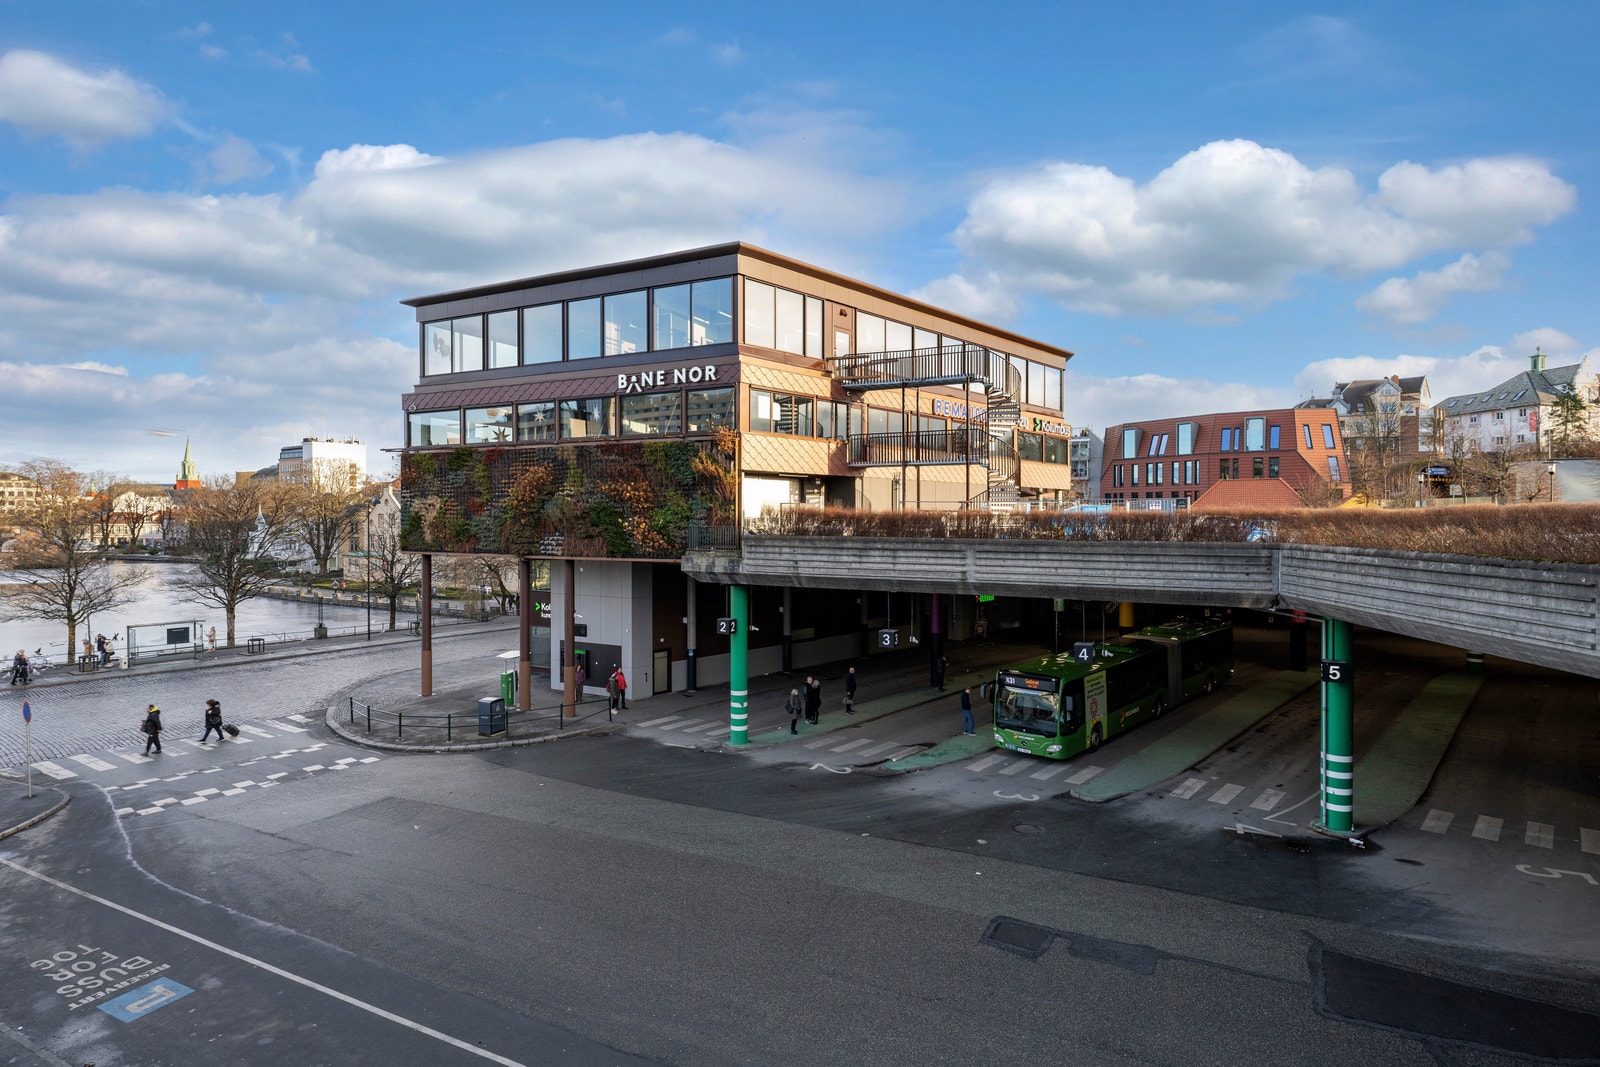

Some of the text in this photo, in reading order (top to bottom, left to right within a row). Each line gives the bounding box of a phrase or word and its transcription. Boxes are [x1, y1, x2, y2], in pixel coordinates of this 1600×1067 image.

[618, 365, 717, 394] BANE NOR
[934, 399, 992, 423] REMA 100
[1042, 419, 1072, 436] Kolumbus
[719, 621, 727, 632] 2
[730, 621, 736, 632] 2
[882, 633, 891, 646] 3
[1078, 648, 1089, 661] 4
[1328, 665, 1341, 680] 5
[30, 944, 101, 971] TOG
[44, 951, 119, 981] FOR
[56, 956, 153, 998] BUSS
[68, 963, 171, 1011] RESERVERT
